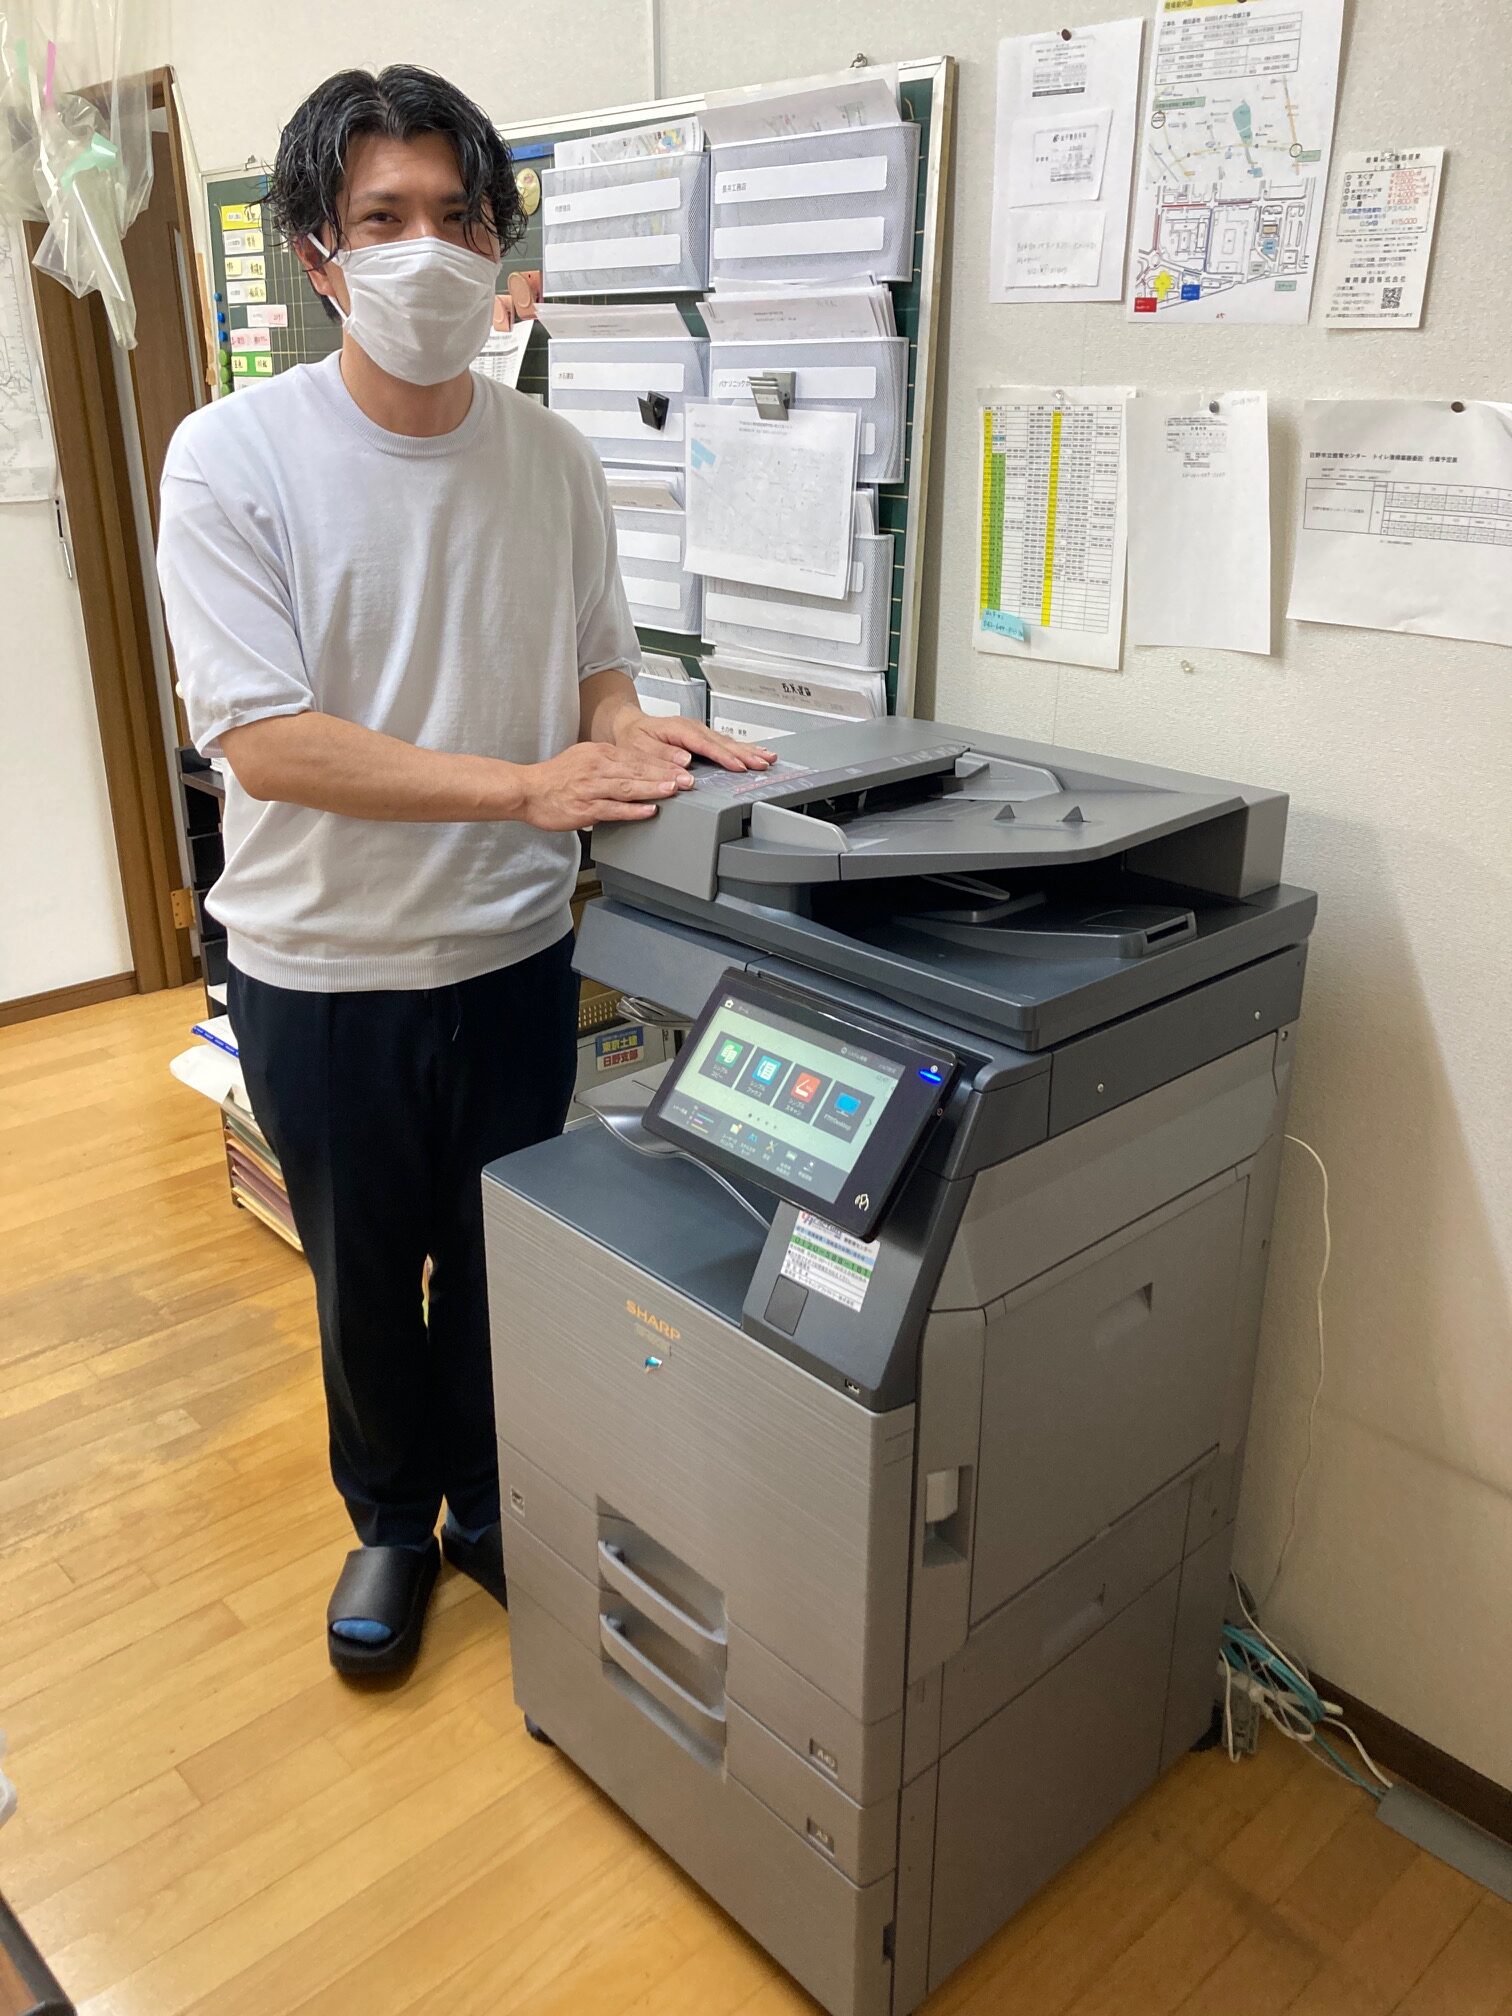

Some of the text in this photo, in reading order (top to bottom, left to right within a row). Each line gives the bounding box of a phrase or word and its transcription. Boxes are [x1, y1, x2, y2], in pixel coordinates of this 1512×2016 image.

[603, 1048, 639, 1068] 日野支部
[625, 1299, 681, 1340] SHARP
